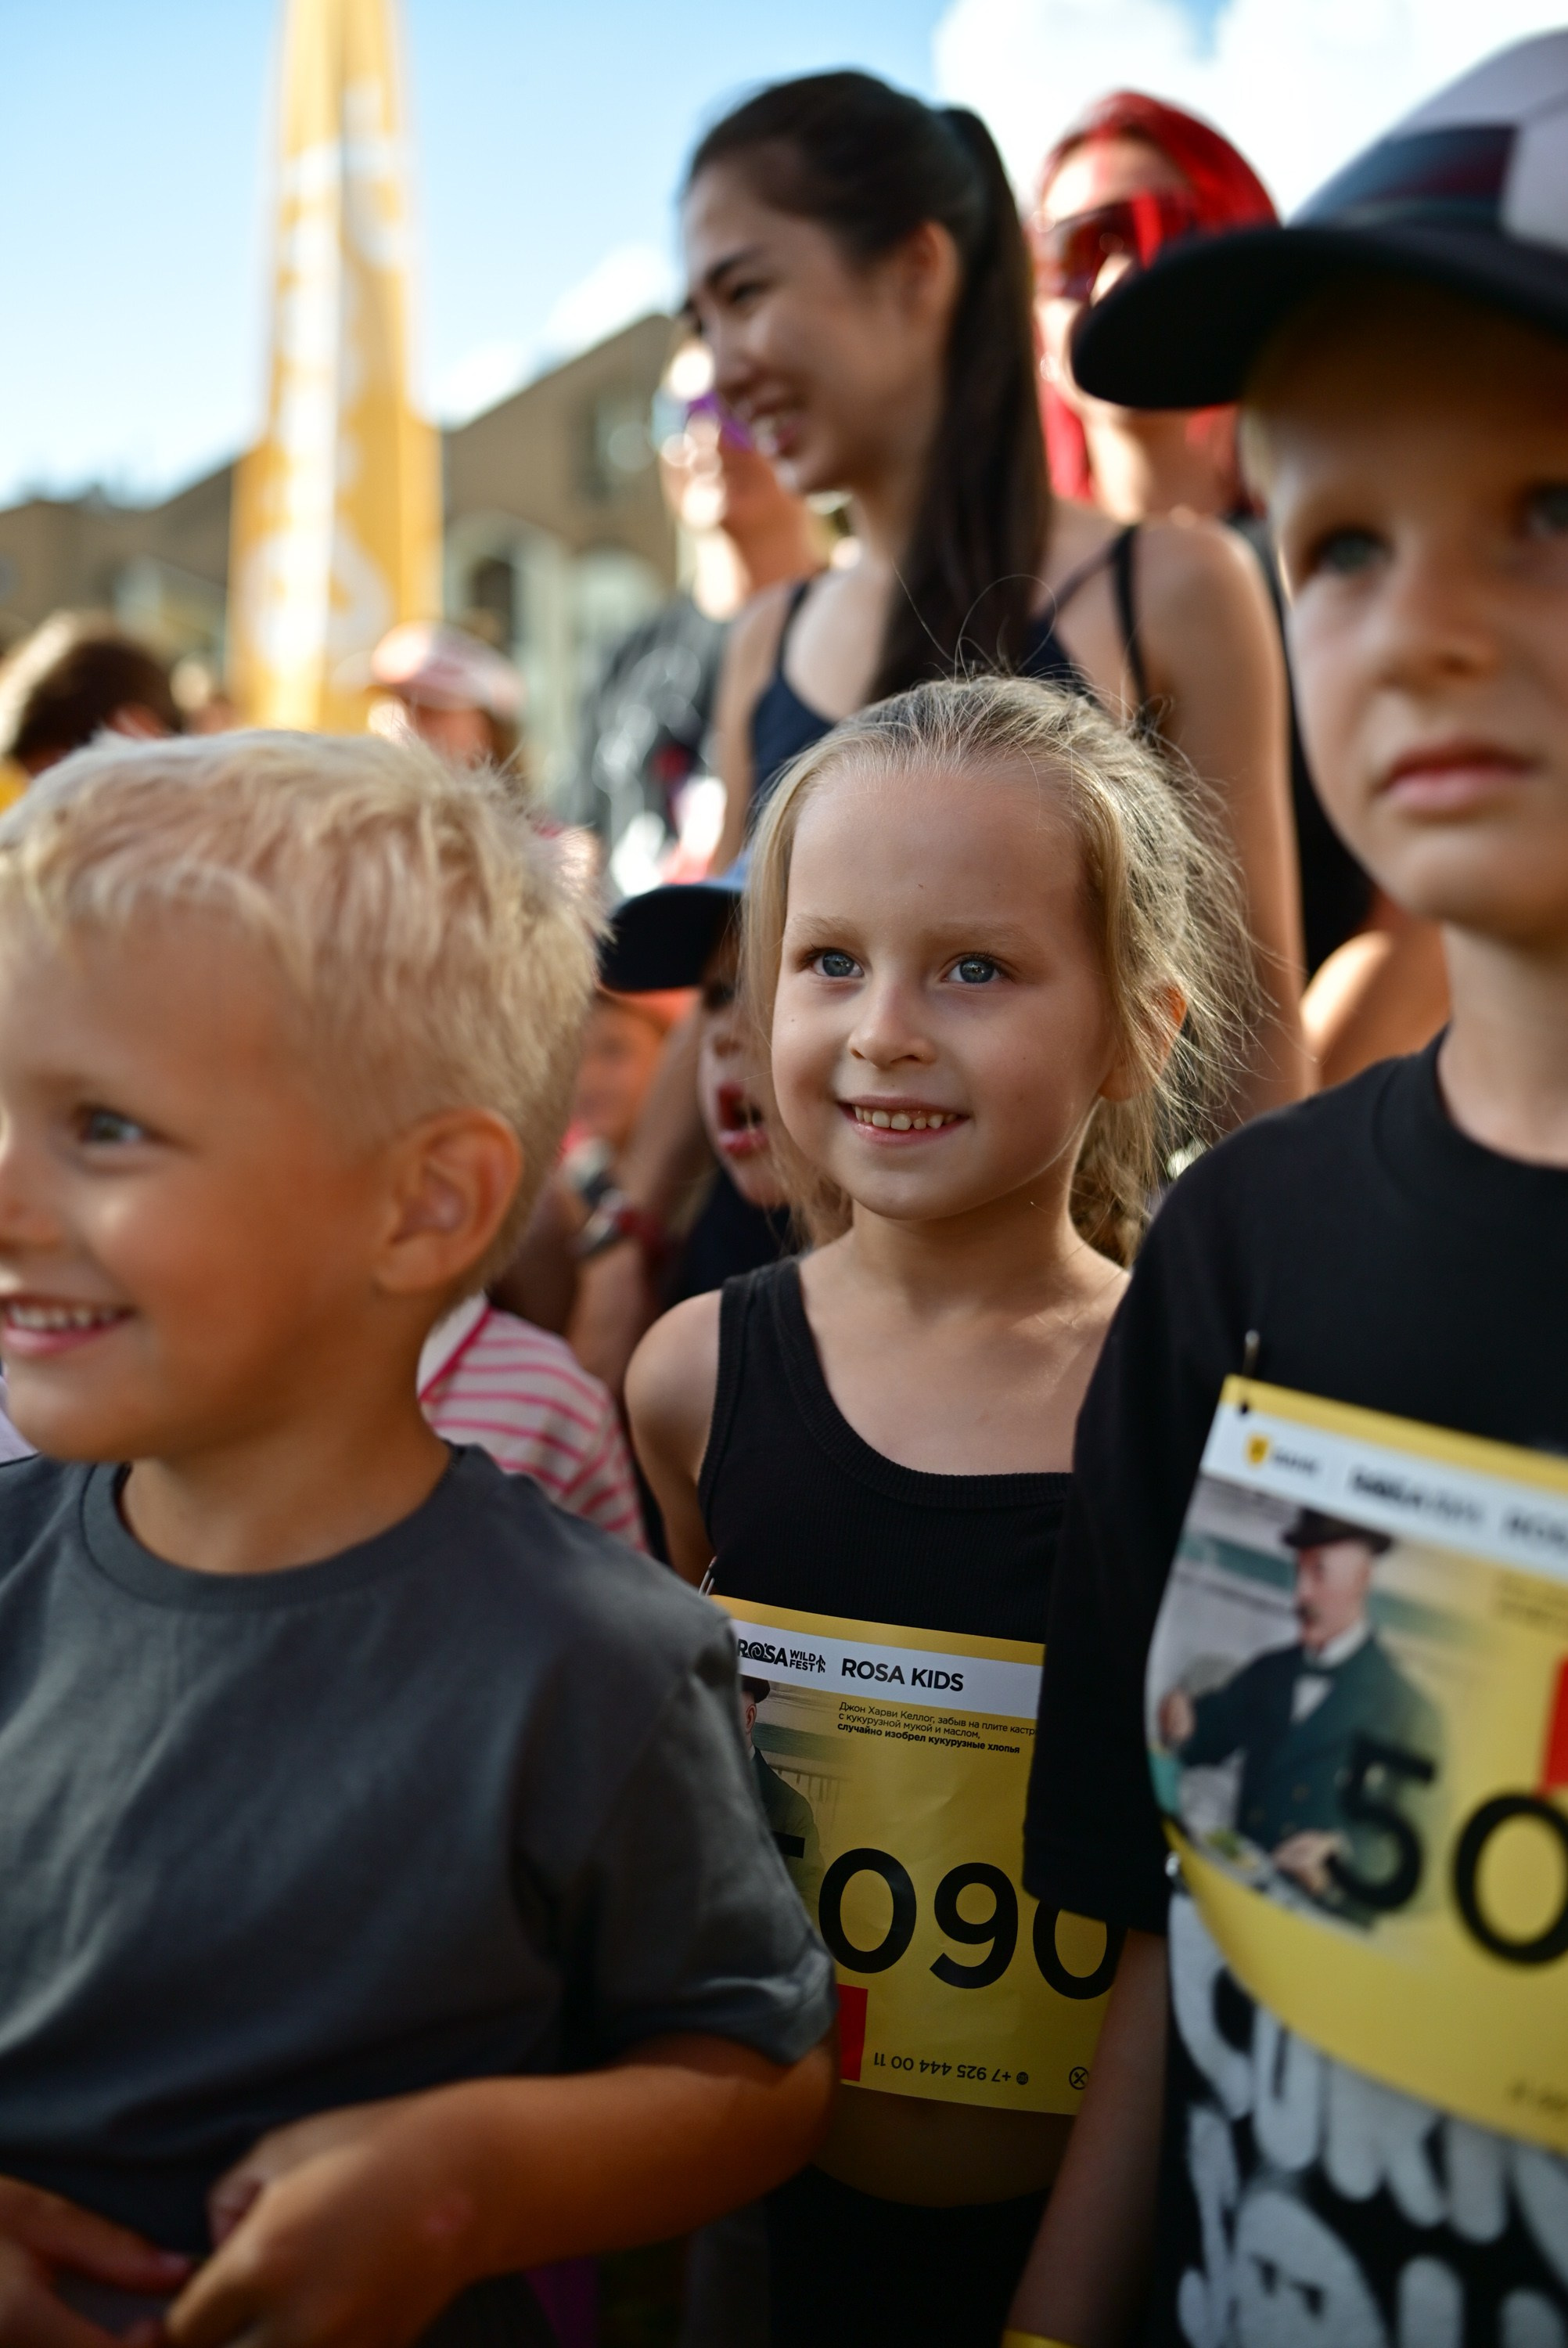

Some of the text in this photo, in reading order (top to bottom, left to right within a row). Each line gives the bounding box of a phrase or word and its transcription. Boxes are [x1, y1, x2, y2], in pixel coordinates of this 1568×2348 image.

[789, 1649, 816, 1662] WILD
[789, 1659, 815, 1672] FEST
[841, 1658, 964, 1692] ROSA KIDS
[840, 1702, 865, 1713] Джон
[869, 1705, 897, 1718] Харви
[901, 1710, 935, 1724] Келлог,
[937, 1717, 966, 1727] забыв
[982, 1723, 1008, 1732] плите
[1010, 1726, 1038, 1736] кастр
[847, 1714, 901, 1728] кукурузной
[903, 1723, 933, 1733] мукой
[944, 1727, 980, 1739] маслом,
[837, 1723, 1020, 1754] случайно изобрел кукурузные хлопья
[771, 1830, 1128, 2000] 090
[873, 2052, 886, 2066] 11
[890, 2055, 914, 2071] 00
[919, 2059, 952, 2076] 444
[957, 2064, 987, 2081] 925
[991, 2069, 1012, 2083] +7
